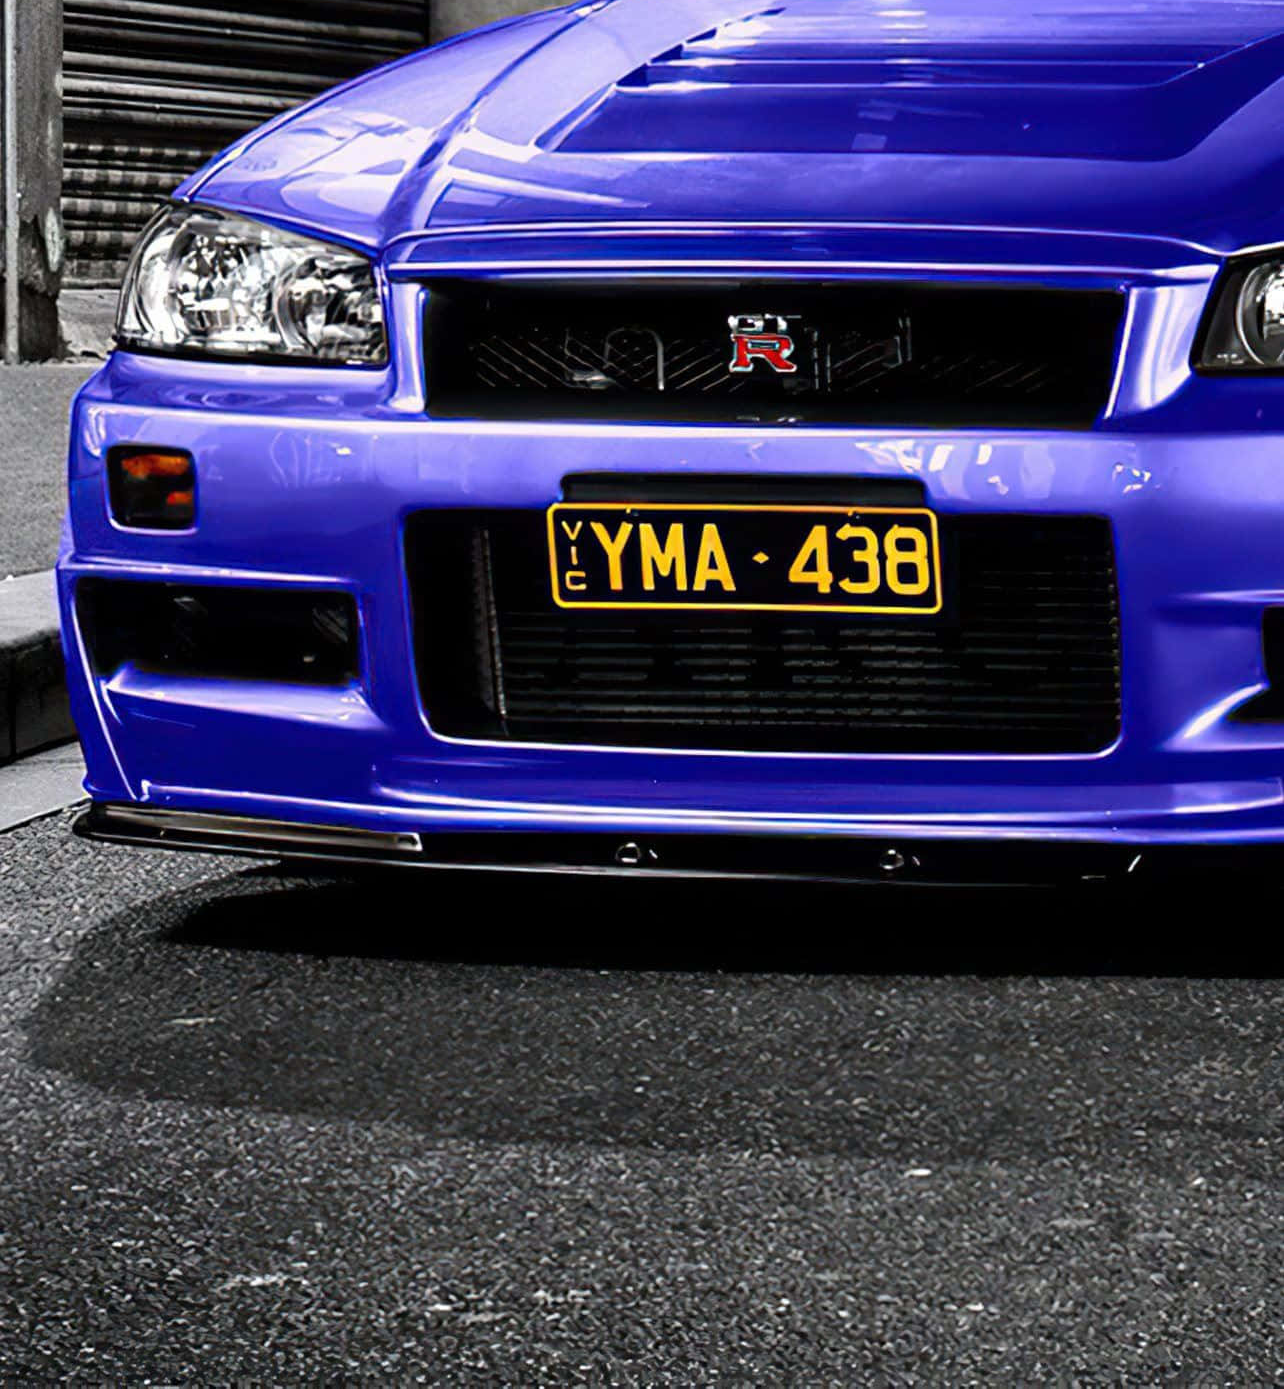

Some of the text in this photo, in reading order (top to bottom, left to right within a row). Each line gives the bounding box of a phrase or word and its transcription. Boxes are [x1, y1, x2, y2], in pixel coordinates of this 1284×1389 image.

[562, 521, 586, 591] VIC
[590, 522, 930, 595] YMA 438
